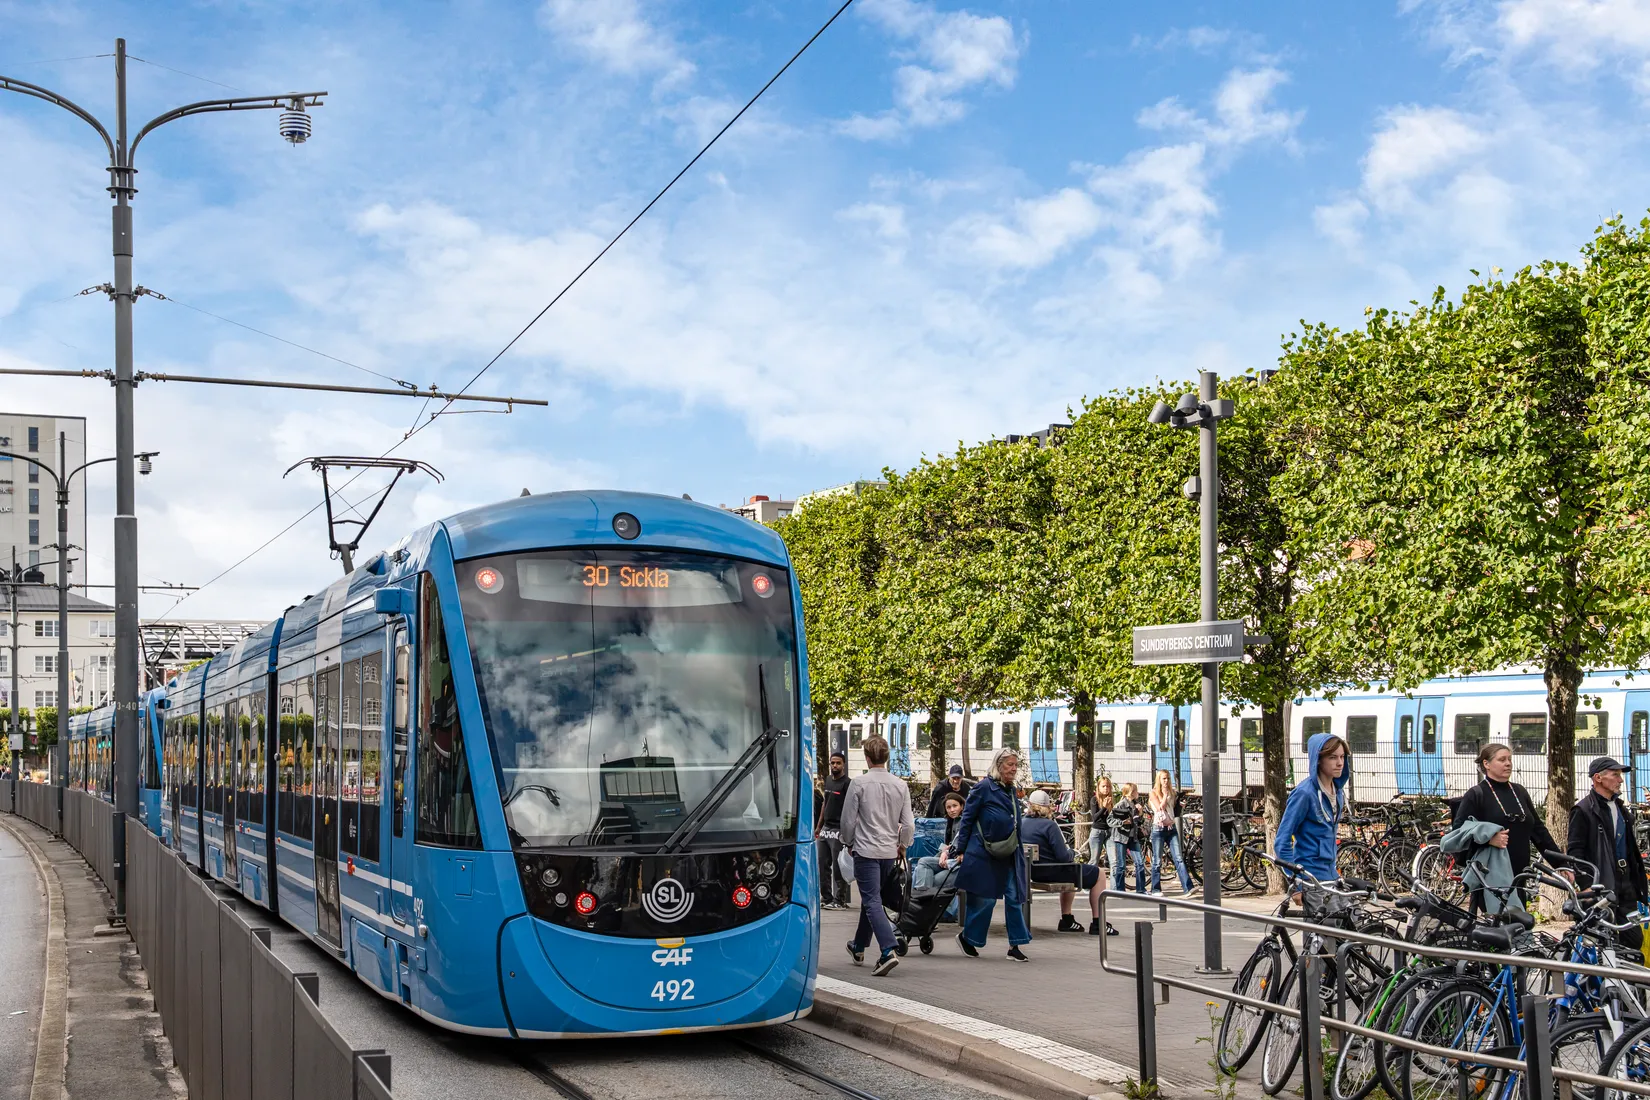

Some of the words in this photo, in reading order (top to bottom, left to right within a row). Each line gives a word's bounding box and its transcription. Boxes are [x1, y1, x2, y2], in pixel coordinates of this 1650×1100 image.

[583, 565, 609, 587] 30
[620, 566, 669, 588] Sickla
[1140, 636, 1193, 652] SUNDBYBERGS
[1194, 634, 1233, 649] CENTRUM
[116, 701, 137, 710] 3-40
[657, 886, 680, 904] SL
[651, 947, 693, 967] CAF
[650, 978, 695, 1002] 492
